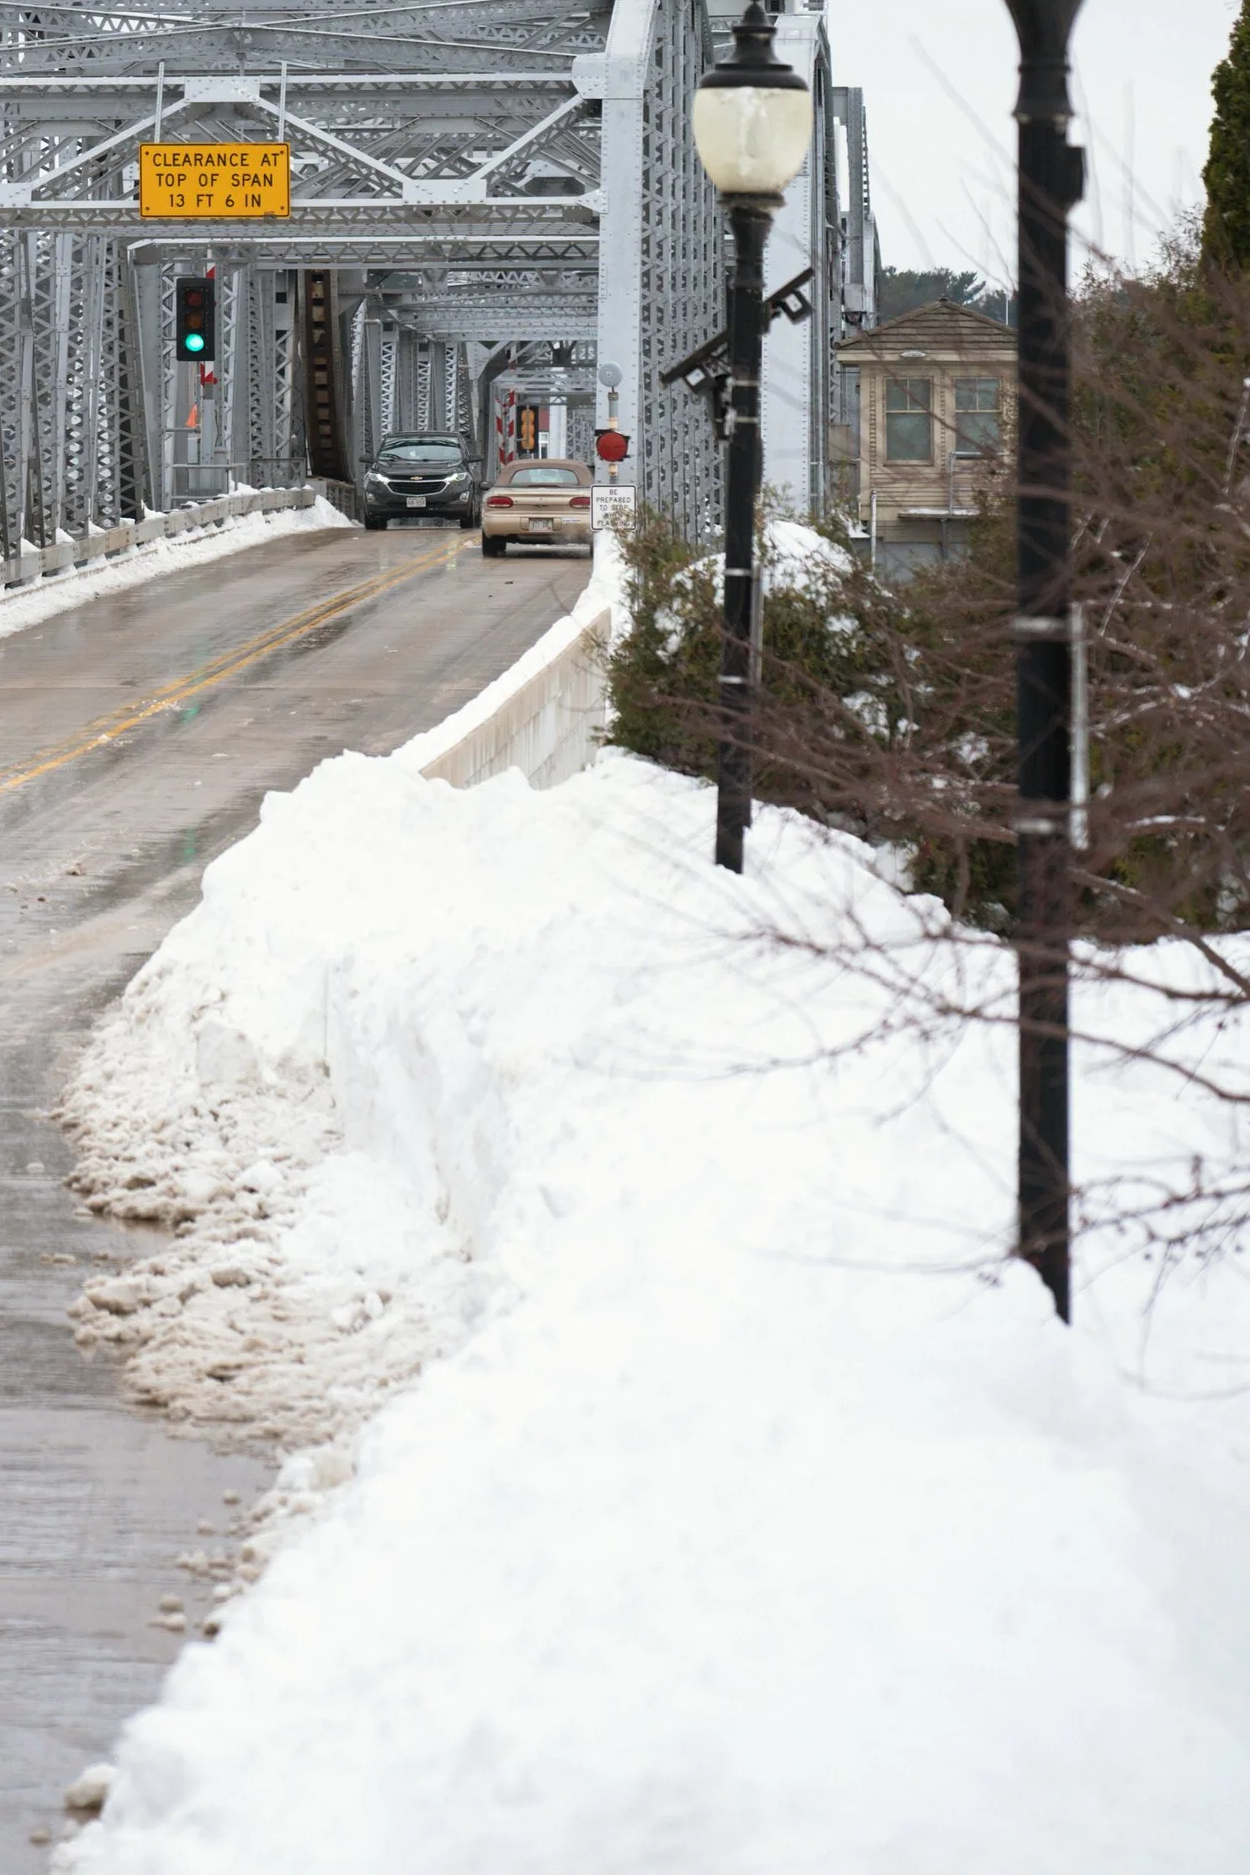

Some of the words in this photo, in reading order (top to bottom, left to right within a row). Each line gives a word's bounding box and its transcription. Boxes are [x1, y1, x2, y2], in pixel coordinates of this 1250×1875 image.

[152, 153, 249, 167] CLEARANCE
[260, 153, 280, 166] AT
[156, 173, 187, 187] TOP
[198, 173, 219, 187] OF
[231, 173, 273, 187] SPAN
[169, 193, 185, 207] 13
[196, 194, 214, 207] FT
[225, 194, 235, 207] 6
[244, 194, 261, 207] IN
